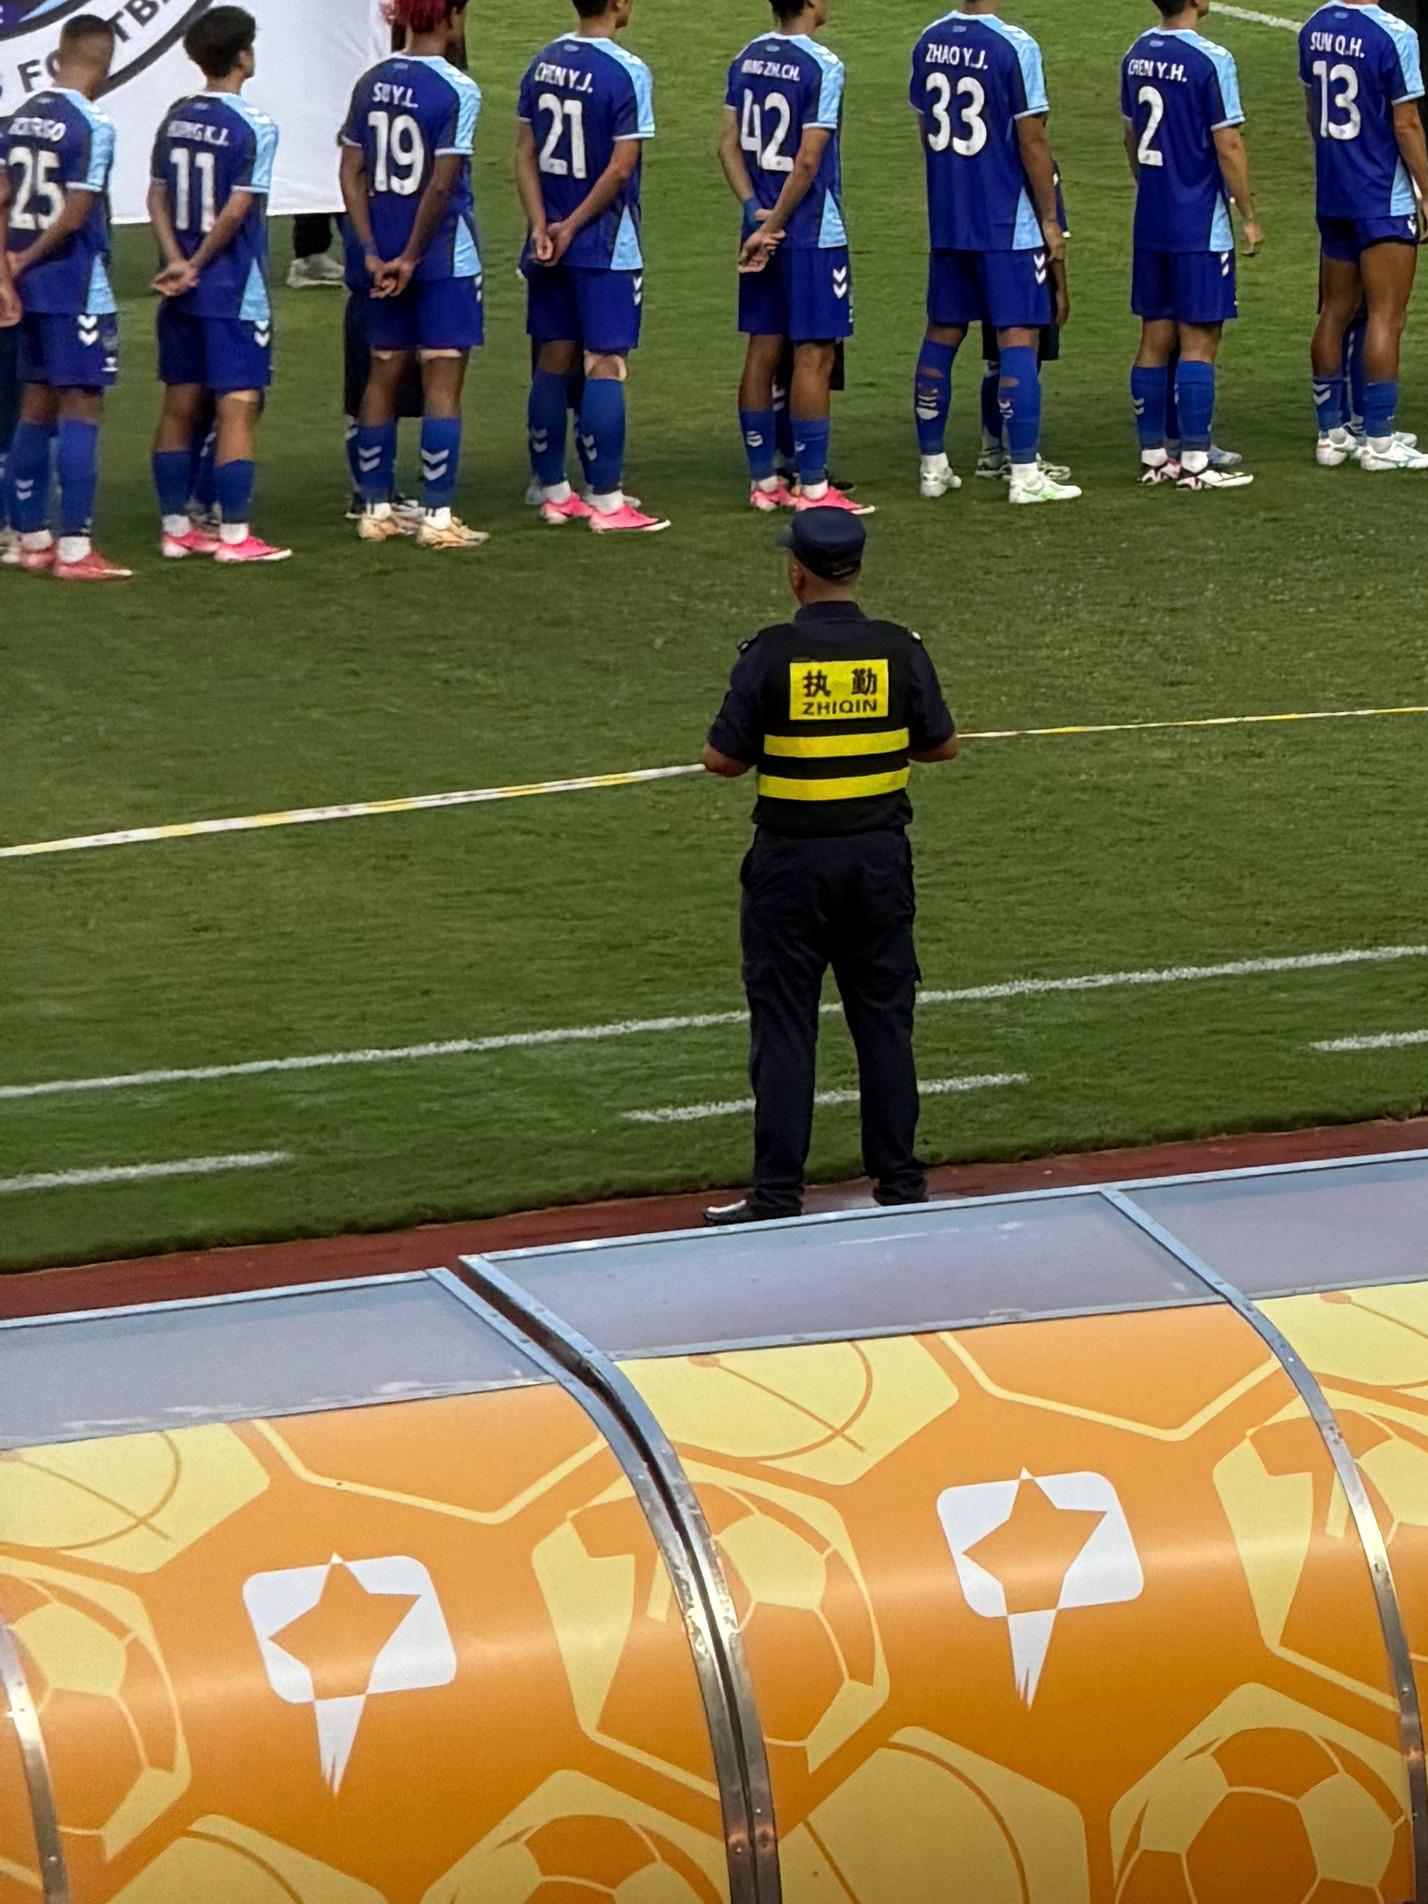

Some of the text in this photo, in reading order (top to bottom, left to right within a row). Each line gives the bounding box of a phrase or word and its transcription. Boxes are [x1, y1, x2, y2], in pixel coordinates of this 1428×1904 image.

[534, 61, 565, 85] CHEN
[925, 42, 960, 67] ZHAO
[1127, 57, 1154, 78] CHEN
[1310, 31, 1333, 52] SUN
[538, 92, 588, 180] 21
[740, 87, 795, 173] 42
[925, 71, 988, 157] 33
[1136, 85, 1165, 167] 2
[1312, 59, 1362, 141] 13
[8, 145, 66, 231] 25
[169, 147, 216, 233] 11
[367, 110, 425, 196] 19
[801, 698, 878, 716] ZHIQIN
[802, 666, 878, 699] 执勤
